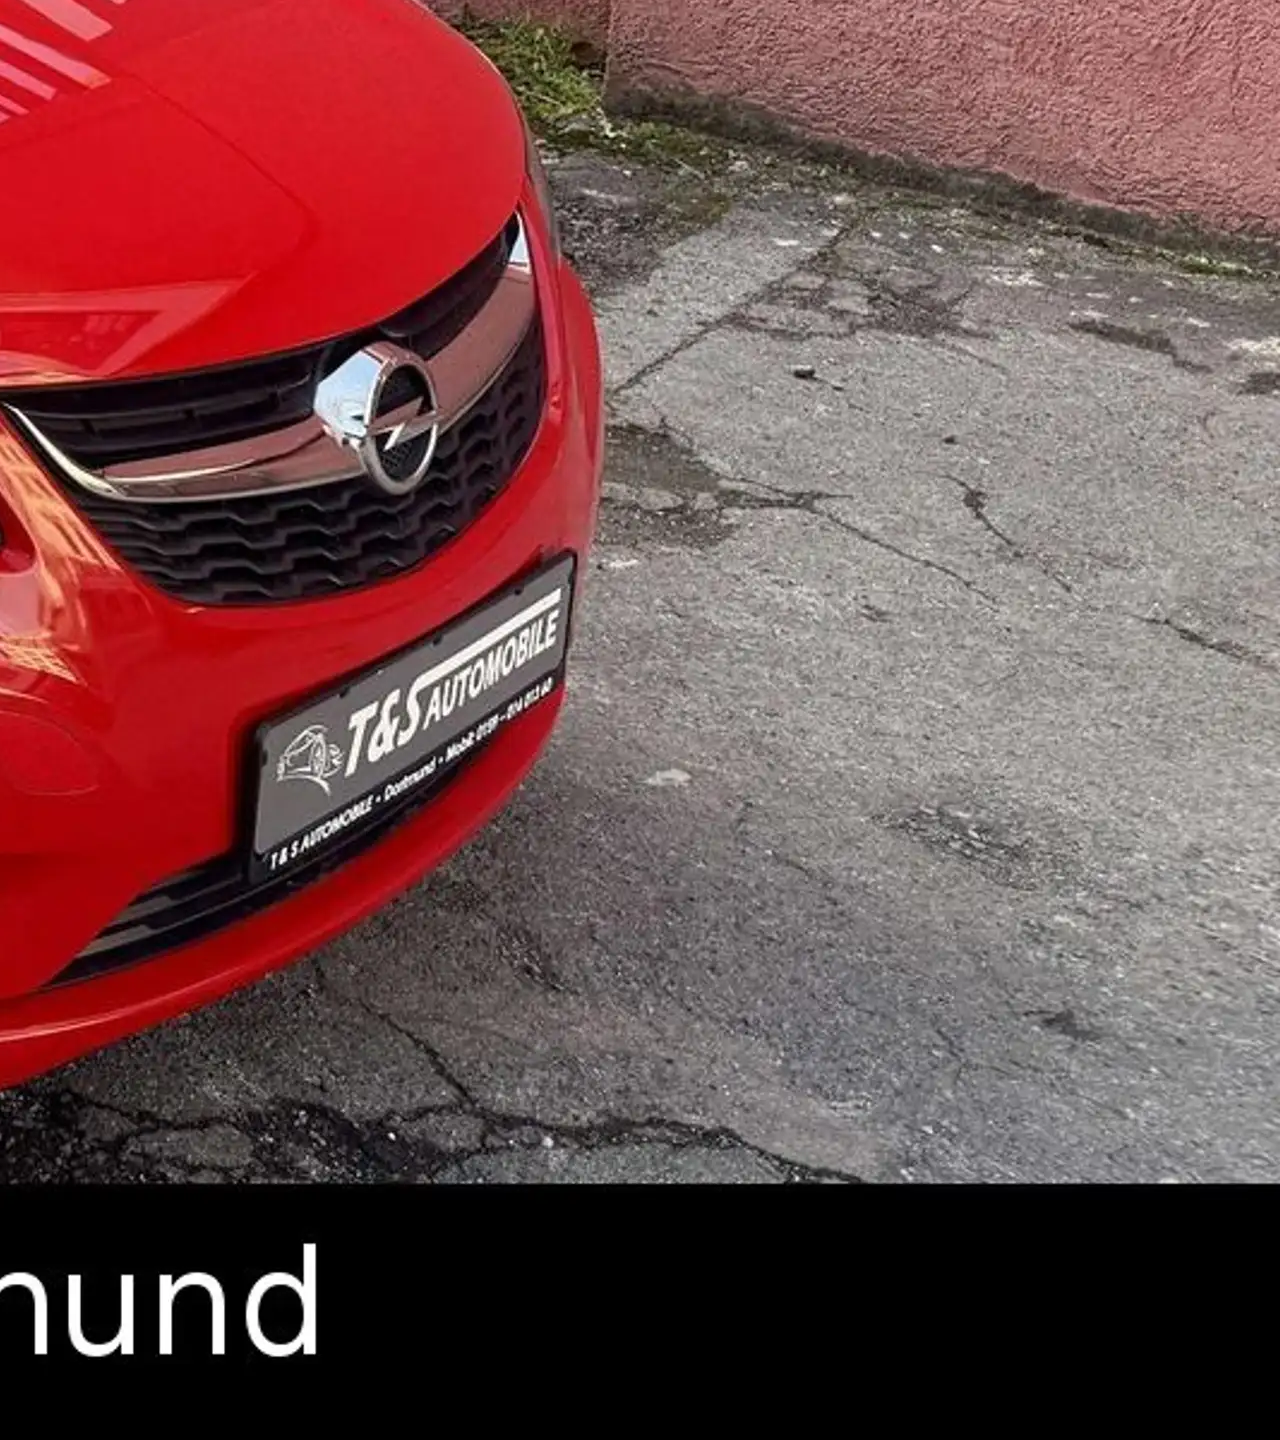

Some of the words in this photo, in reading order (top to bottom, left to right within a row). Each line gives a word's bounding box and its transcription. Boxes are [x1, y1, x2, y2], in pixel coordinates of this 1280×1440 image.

[344, 675, 421, 777] T&S
[423, 609, 560, 731] AUTOMOBILE
[300, 795, 375, 850] AUTOMOBILE
[384, 756, 438, 801] Dortmund
